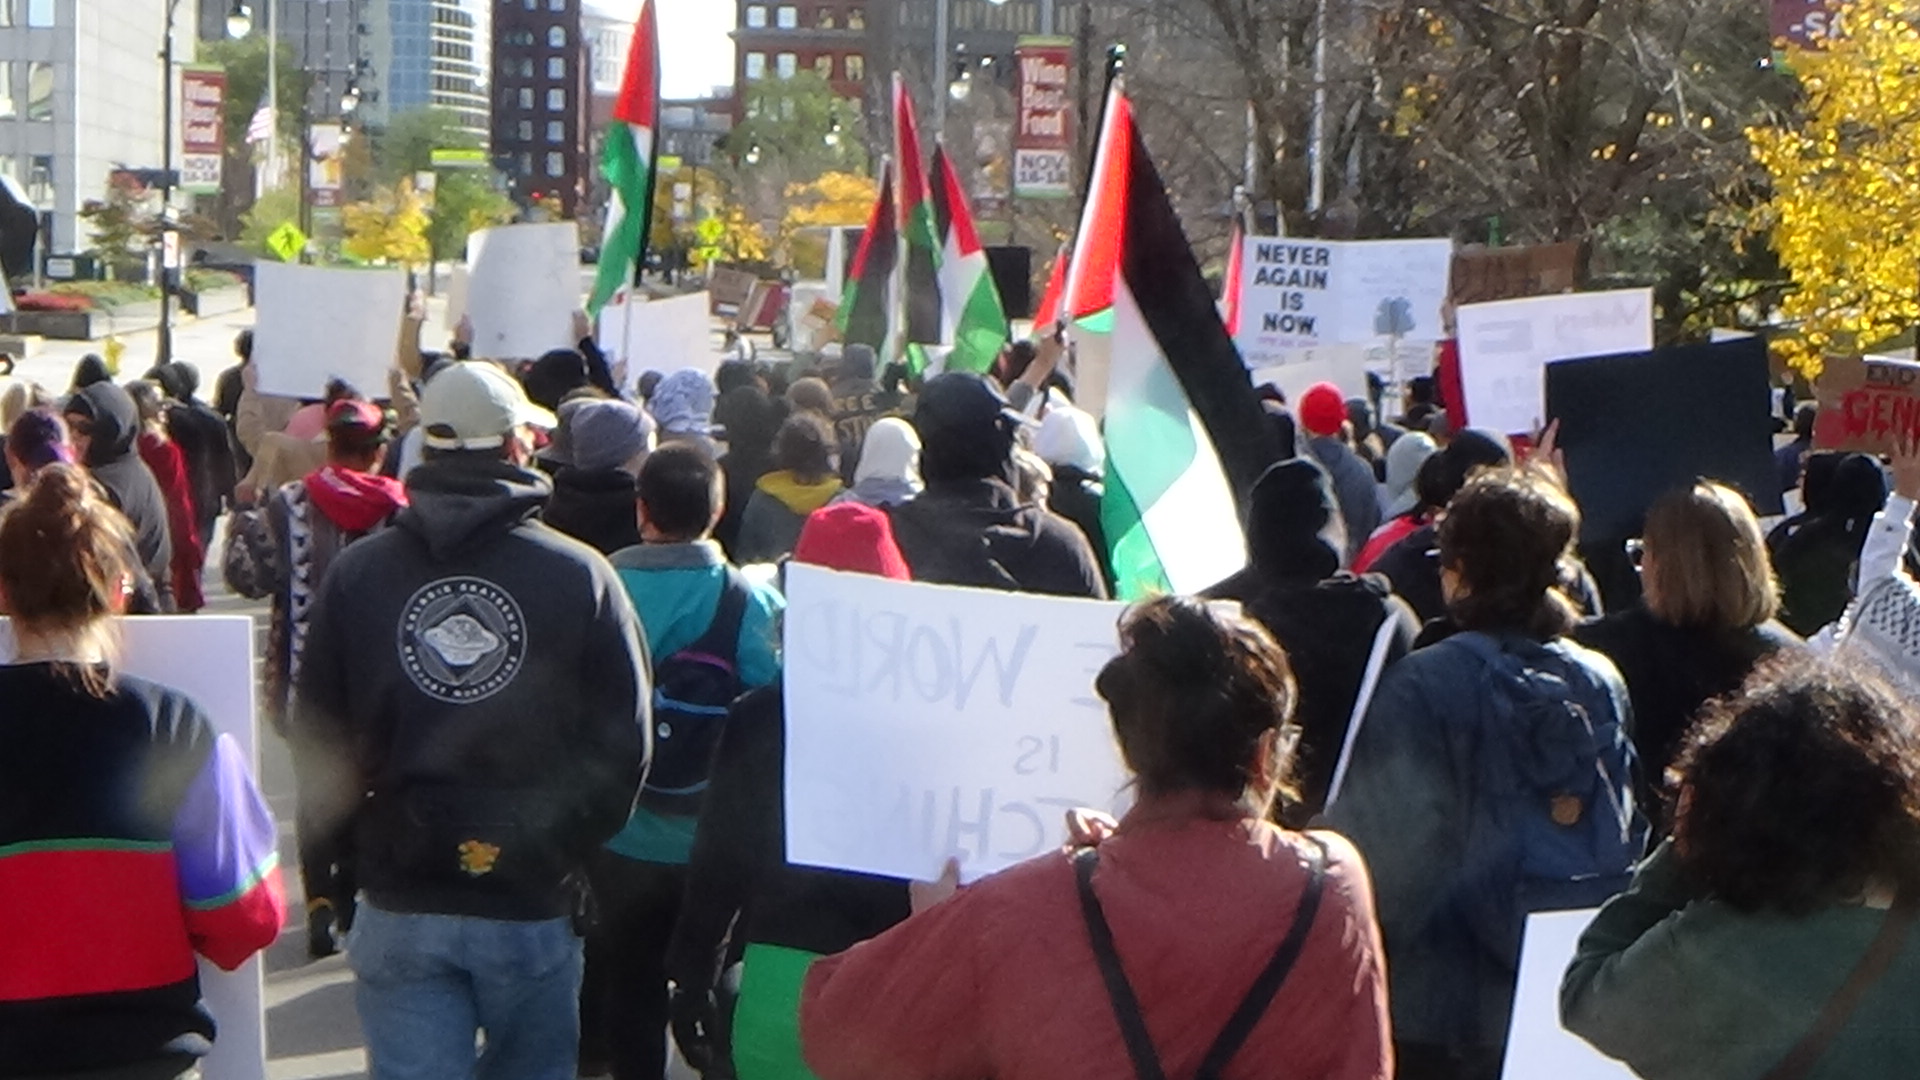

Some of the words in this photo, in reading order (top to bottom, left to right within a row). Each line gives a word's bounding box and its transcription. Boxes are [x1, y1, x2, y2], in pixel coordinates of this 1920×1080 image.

[1021, 57, 1066, 84] Wine
[1021, 108, 1062, 135] Food
[1256, 243, 1330, 266] NEVER
[1253, 266, 1328, 289] AGAIN
[1280, 291, 1304, 311] IS
[1262, 313, 1318, 337] NOW.
